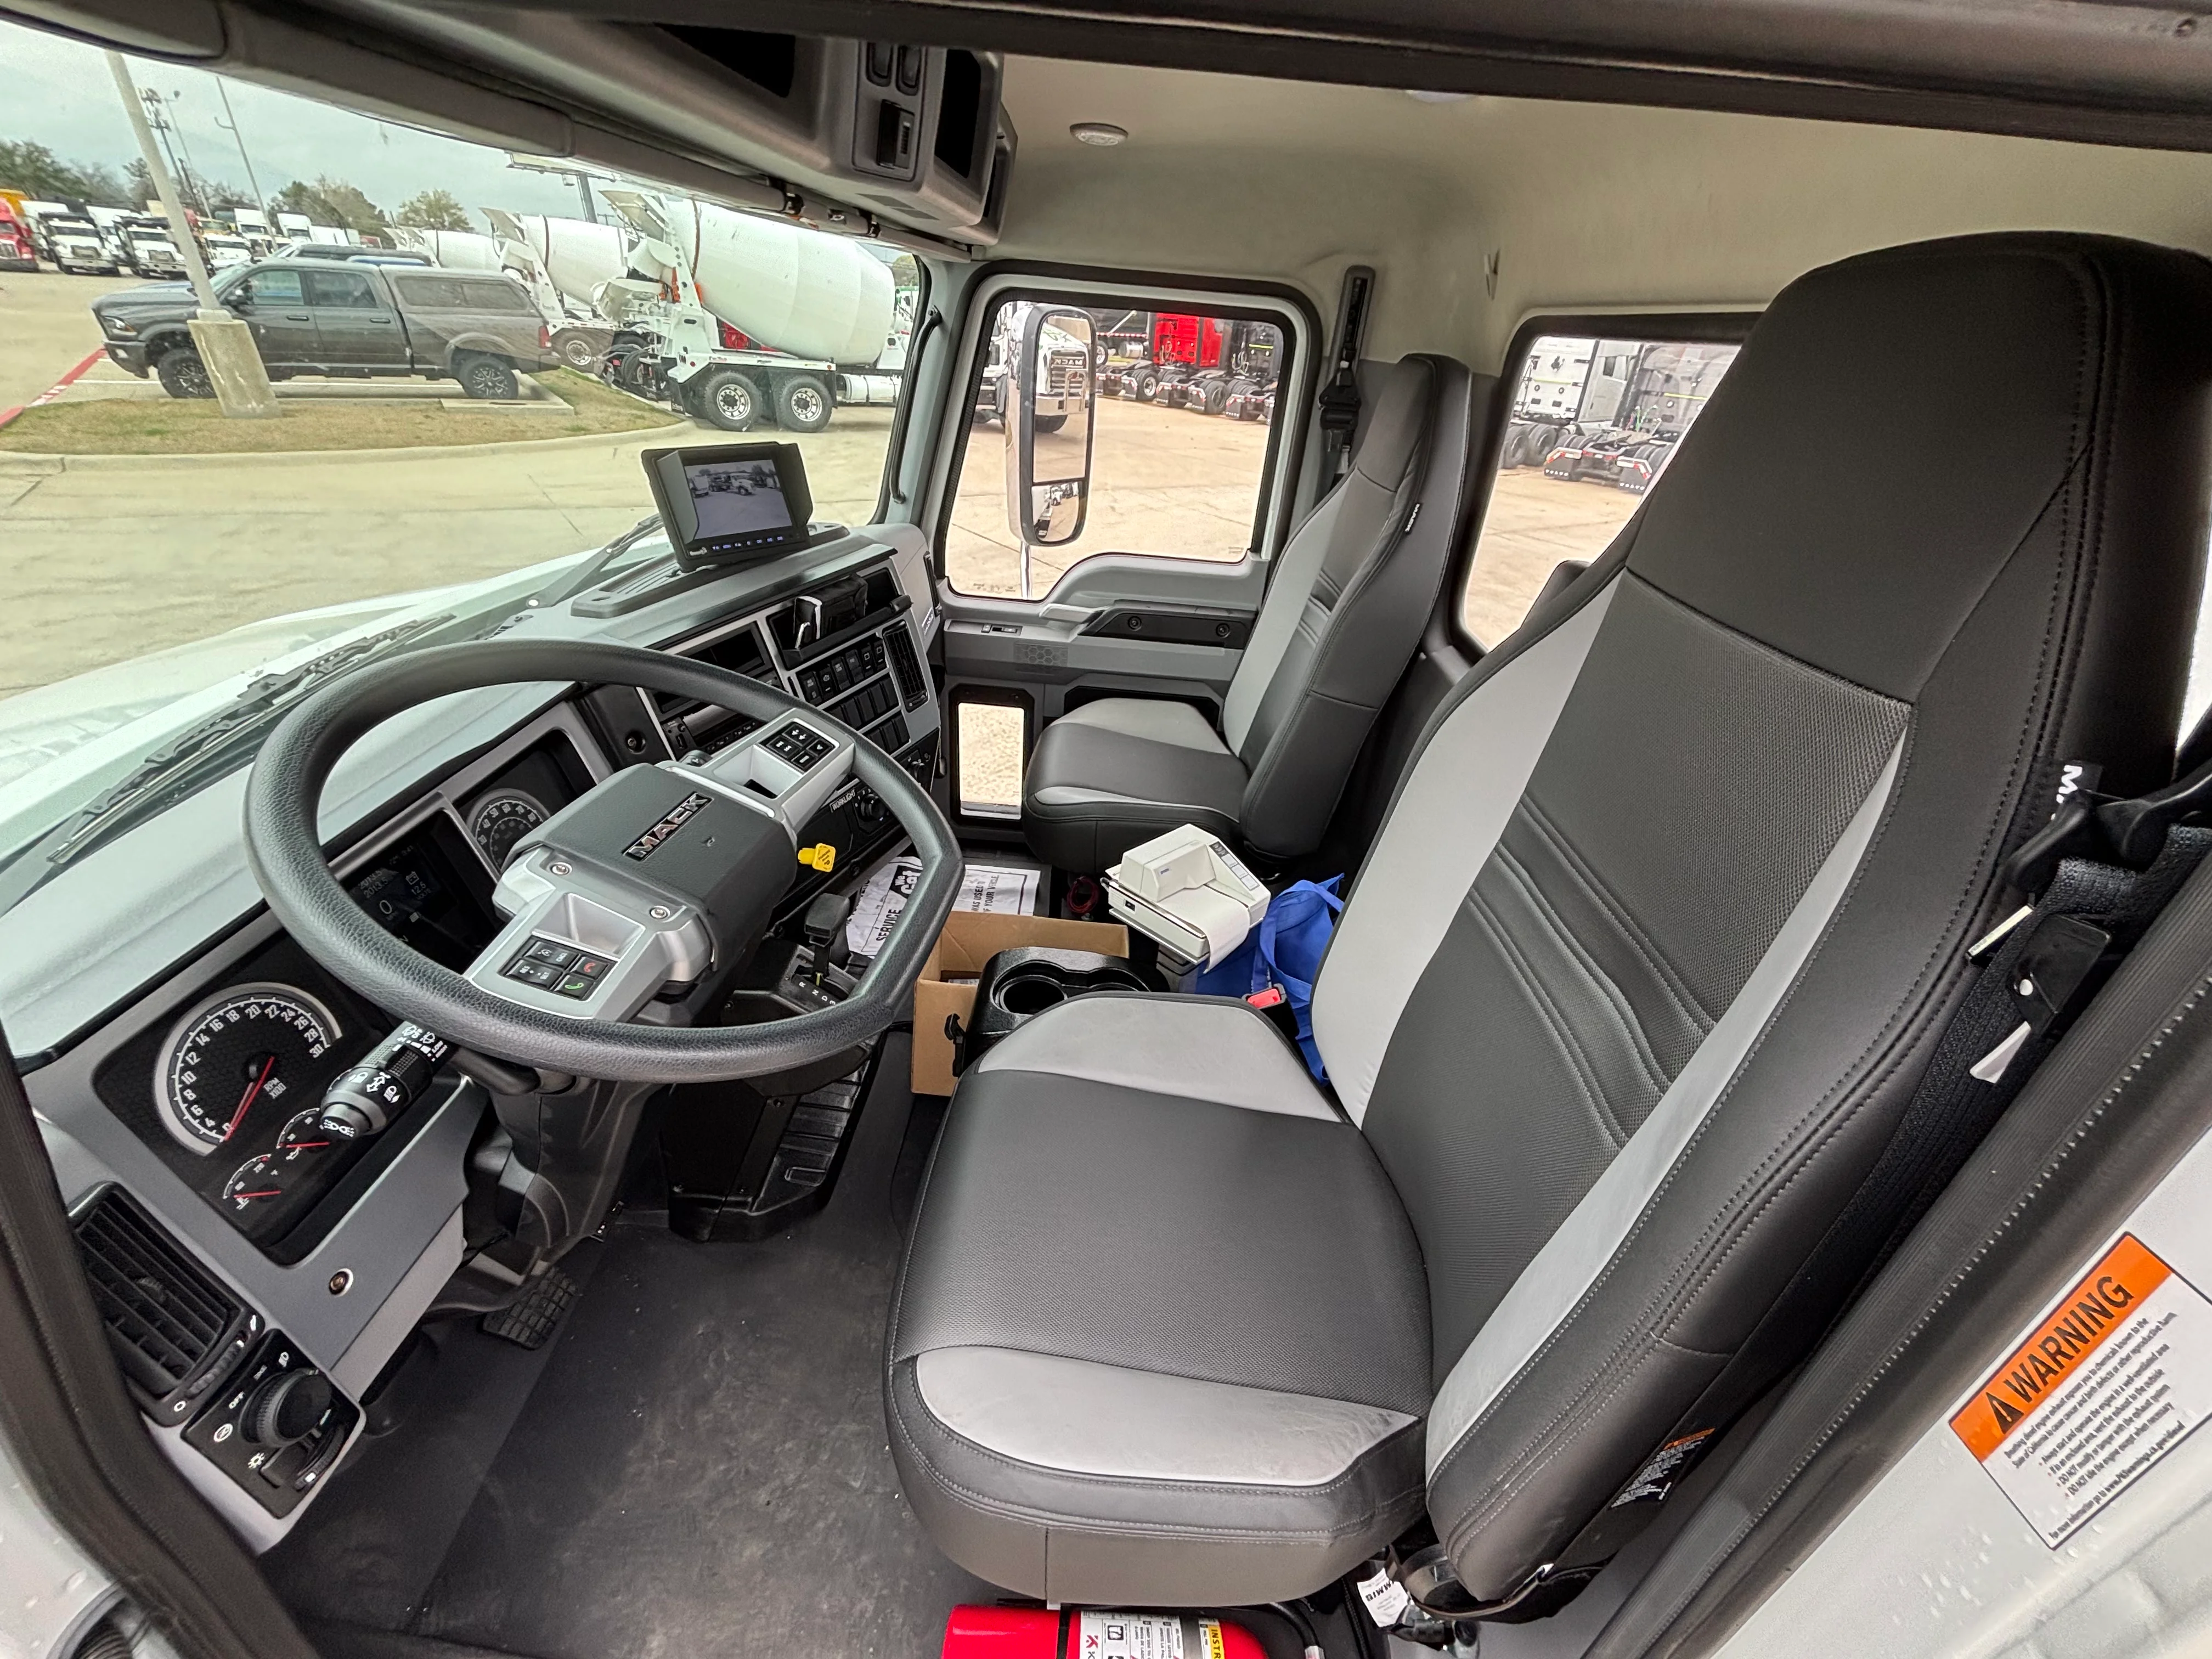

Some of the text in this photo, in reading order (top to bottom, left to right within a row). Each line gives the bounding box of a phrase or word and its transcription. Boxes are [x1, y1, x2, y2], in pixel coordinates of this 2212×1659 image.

[832, 789, 856, 811] WORKLIGHT
[628, 793, 708, 858] MACK
[895, 875, 905, 886] We
[984, 891, 995, 906] YOUR
[876, 909, 902, 941] SERVICE
[225, 1009, 240, 1023] 18
[245, 1004, 261, 1019] 20
[264, 1005, 280, 1019] 22
[281, 1008, 295, 1022] 24
[209, 1018, 224, 1032] 16
[294, 1017, 308, 1030] 26
[195, 1034, 210, 1046] 14
[304, 1028, 318, 1042] 28
[309, 1044, 324, 1058] 30
[185, 1052, 201, 1065] 12
[181, 1071, 197, 1085] 10
[263, 1077, 280, 1092] RPM
[183, 1089, 196, 1101] 8
[191, 1104, 204, 1116] 6
[205, 1118, 215, 1127] 4
[2004, 1276, 2135, 1403] WARNING
